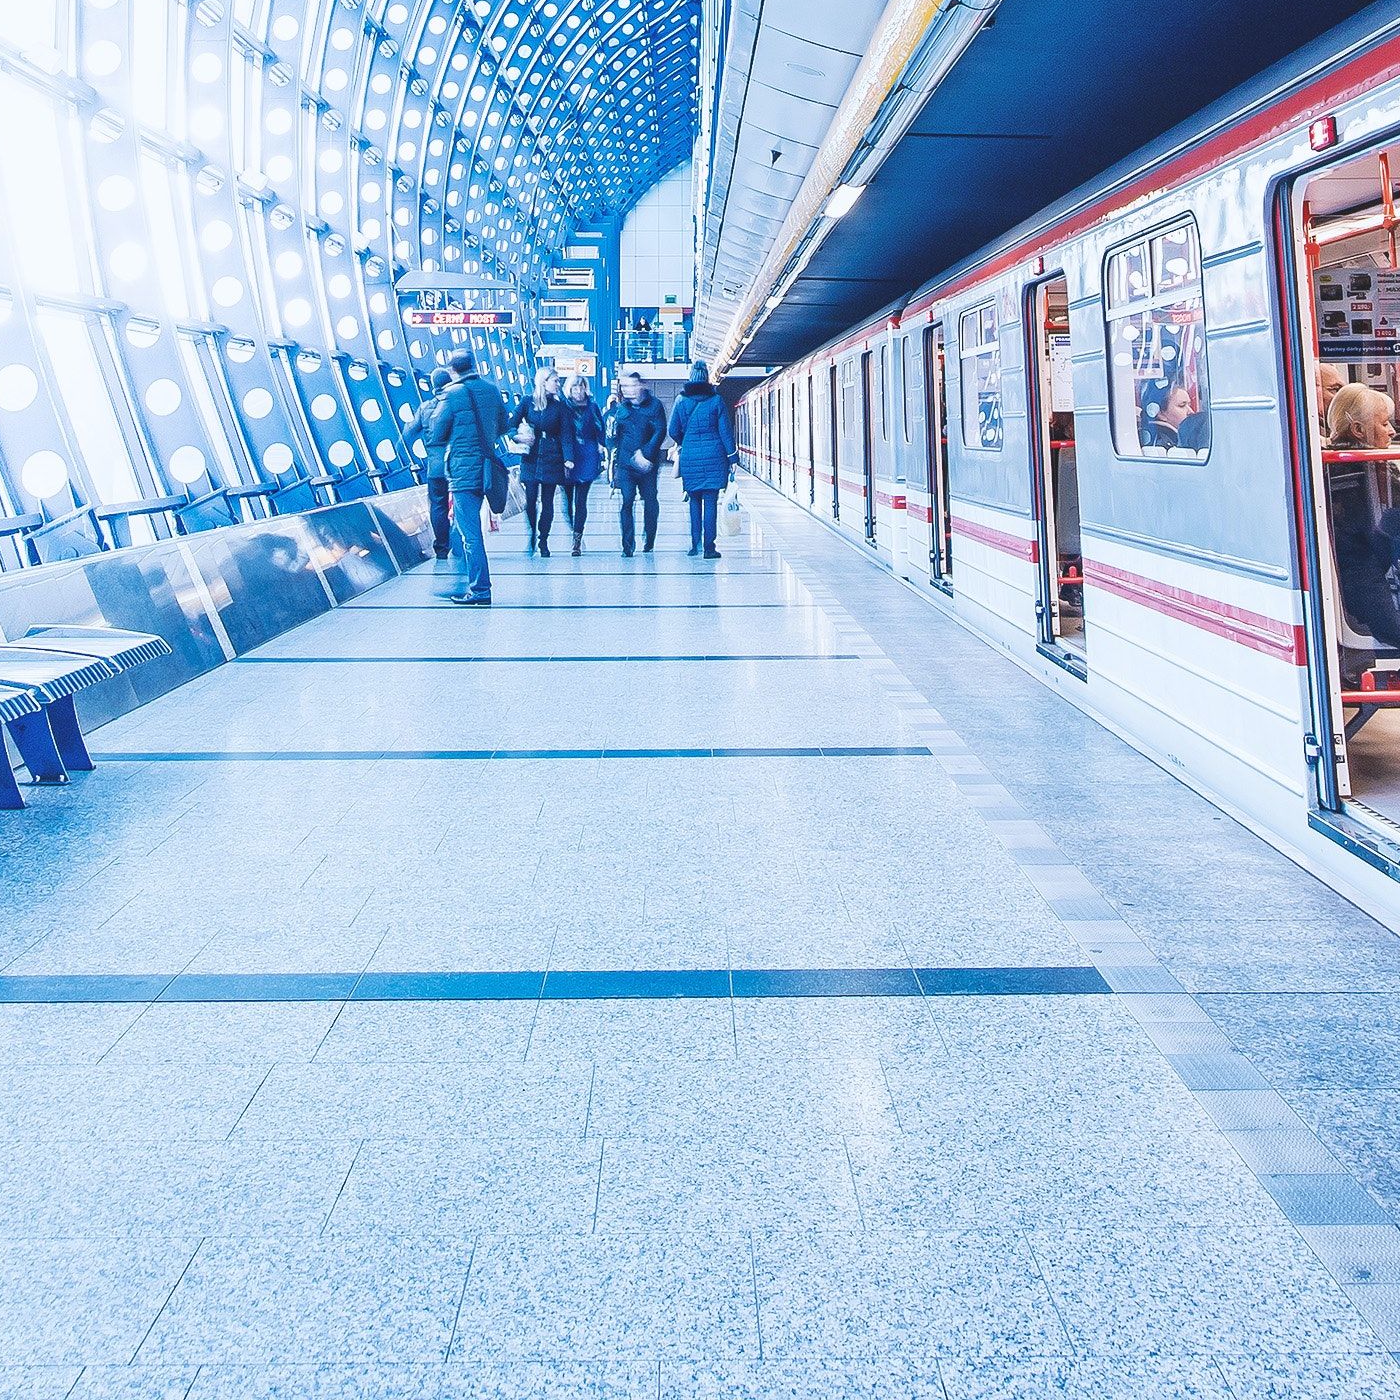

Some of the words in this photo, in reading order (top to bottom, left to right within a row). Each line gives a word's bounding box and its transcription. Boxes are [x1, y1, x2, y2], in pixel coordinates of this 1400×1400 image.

[432, 312, 465, 324] ČERNÝ
[469, 313, 496, 324] MOST
[581, 363, 588, 373] 2
